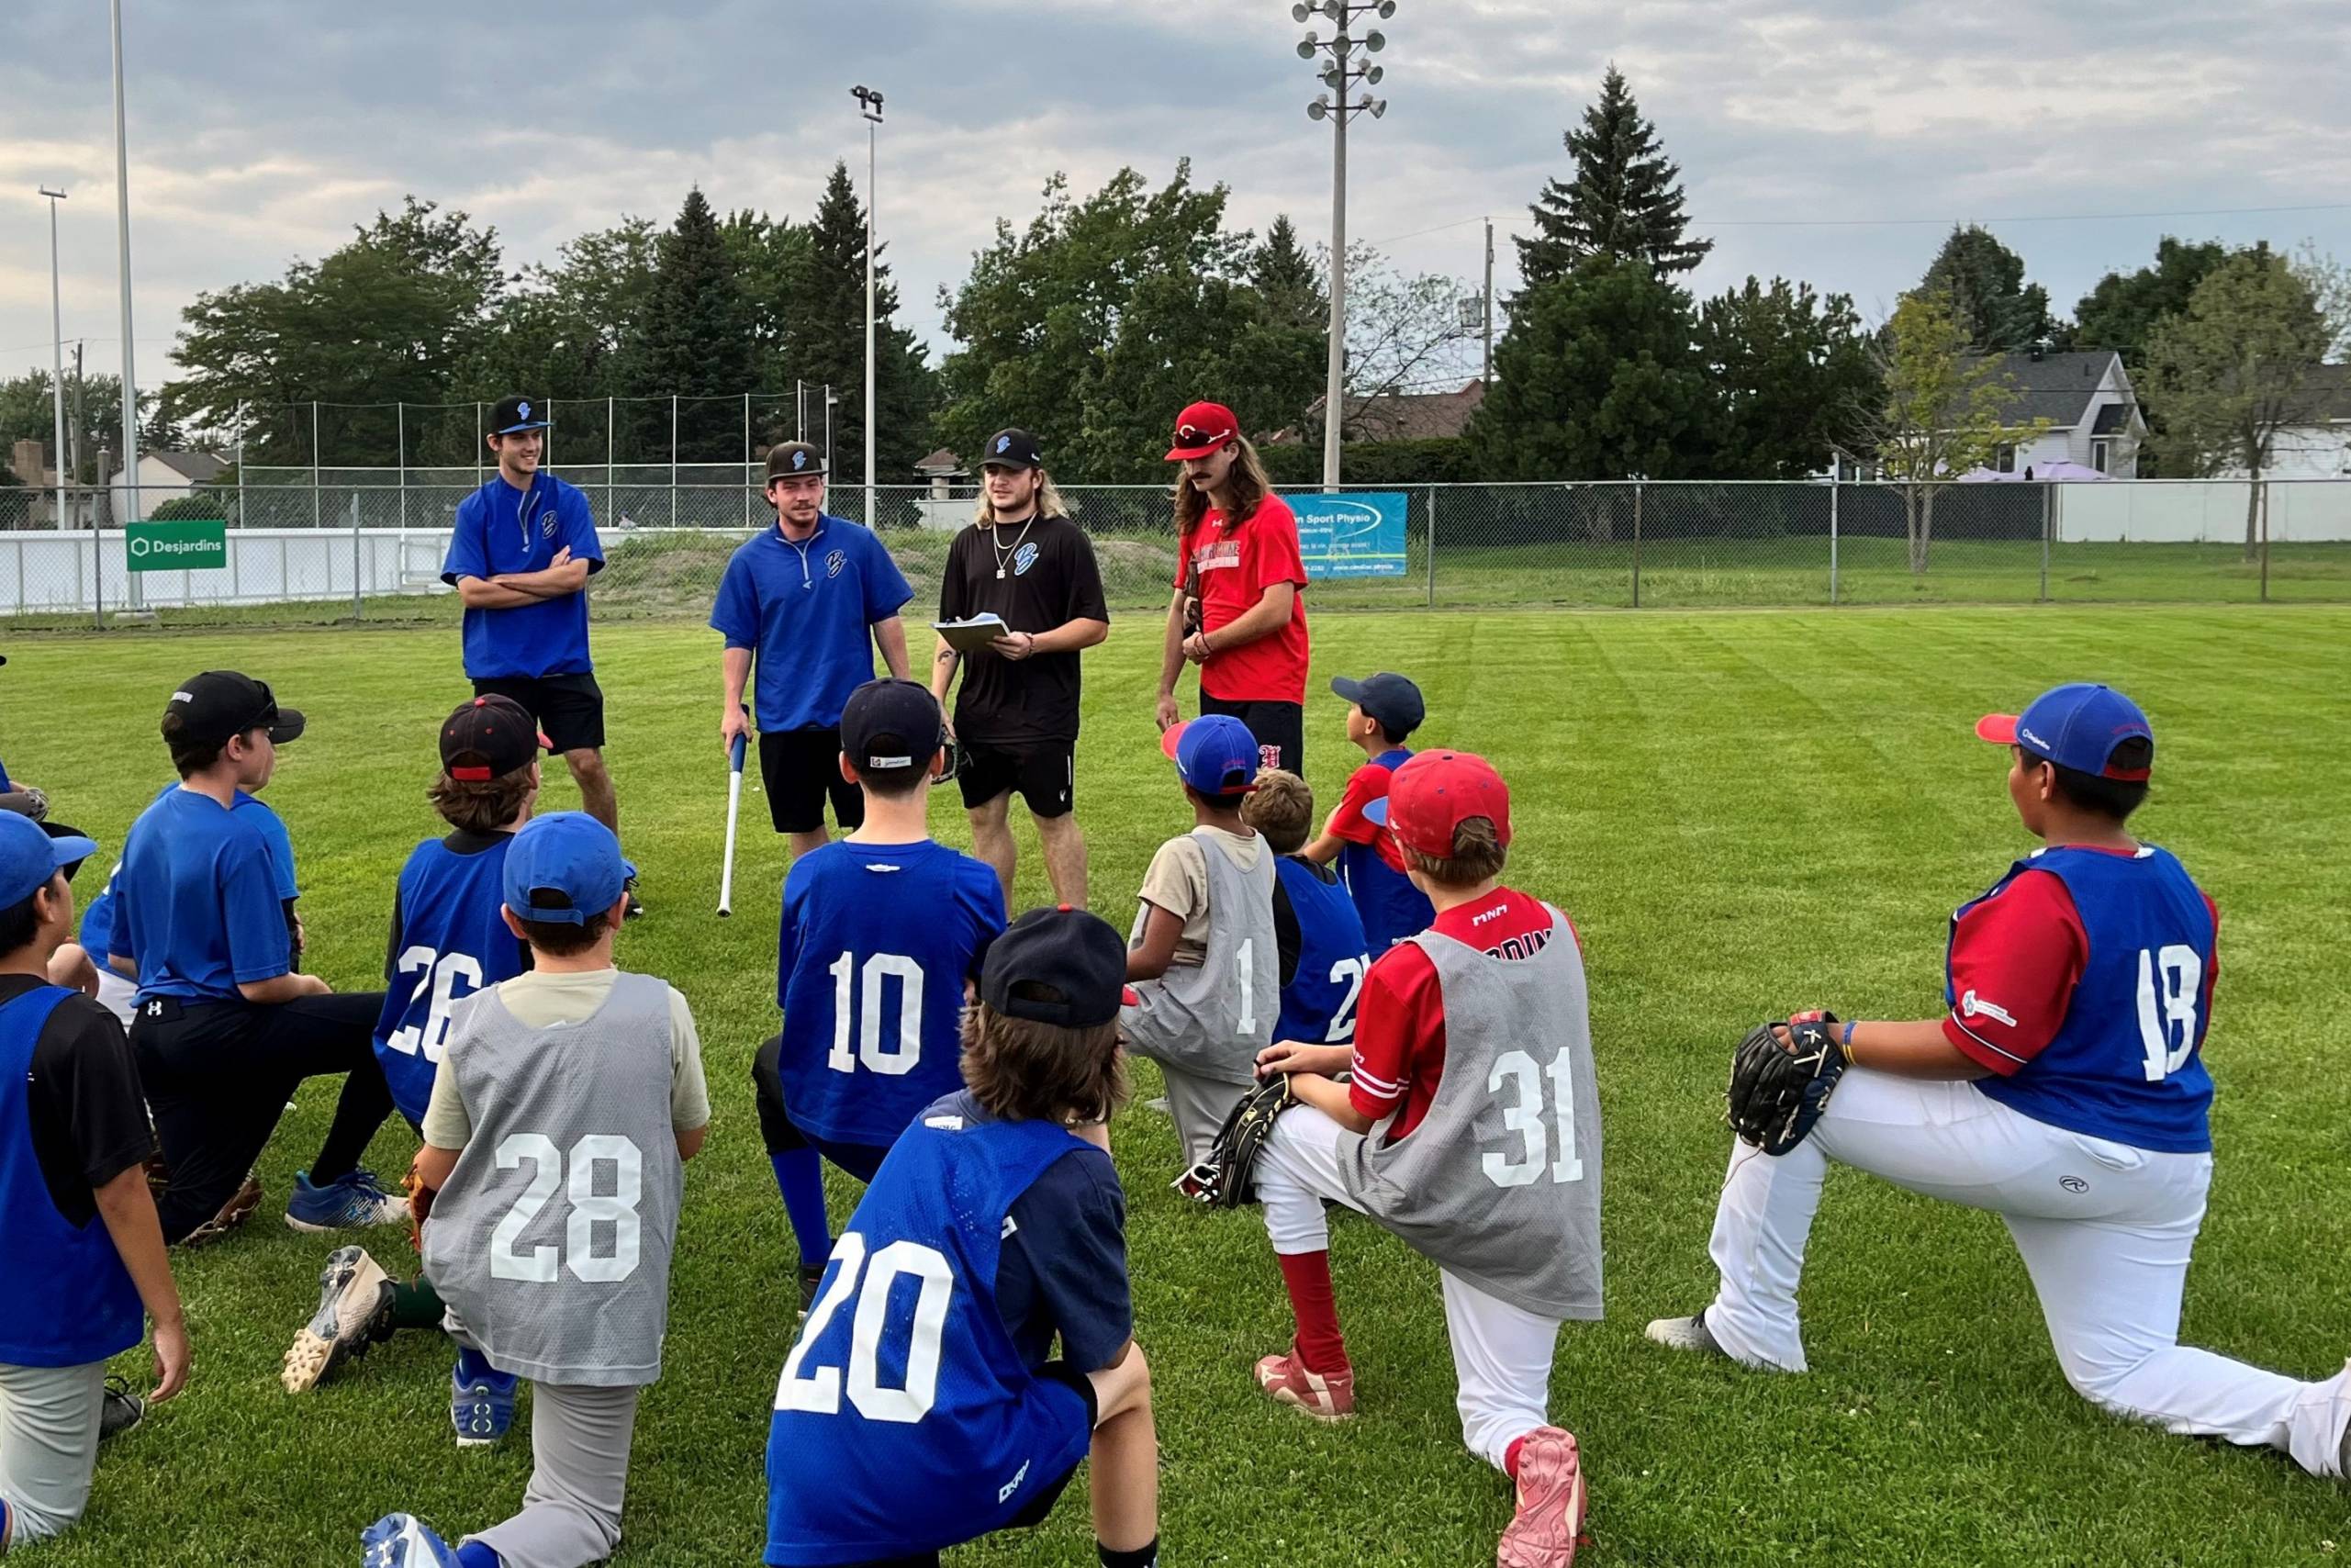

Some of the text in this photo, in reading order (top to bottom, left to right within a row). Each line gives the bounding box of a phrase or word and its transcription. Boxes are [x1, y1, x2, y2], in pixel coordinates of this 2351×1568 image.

[153, 539, 222, 555] Desjardins
[1306, 514, 1335, 525] Sport
[1337, 513, 1371, 524] Physio
[1472, 904, 1507, 926] MNM
[386, 946, 483, 1064] 26
[828, 950, 924, 1075] 10
[1237, 938, 1257, 1035] 1
[2137, 944, 2202, 1081] 18
[1482, 1046, 1584, 1188] 31
[490, 1133, 643, 1282] 28
[774, 1231, 954, 1424] 20
